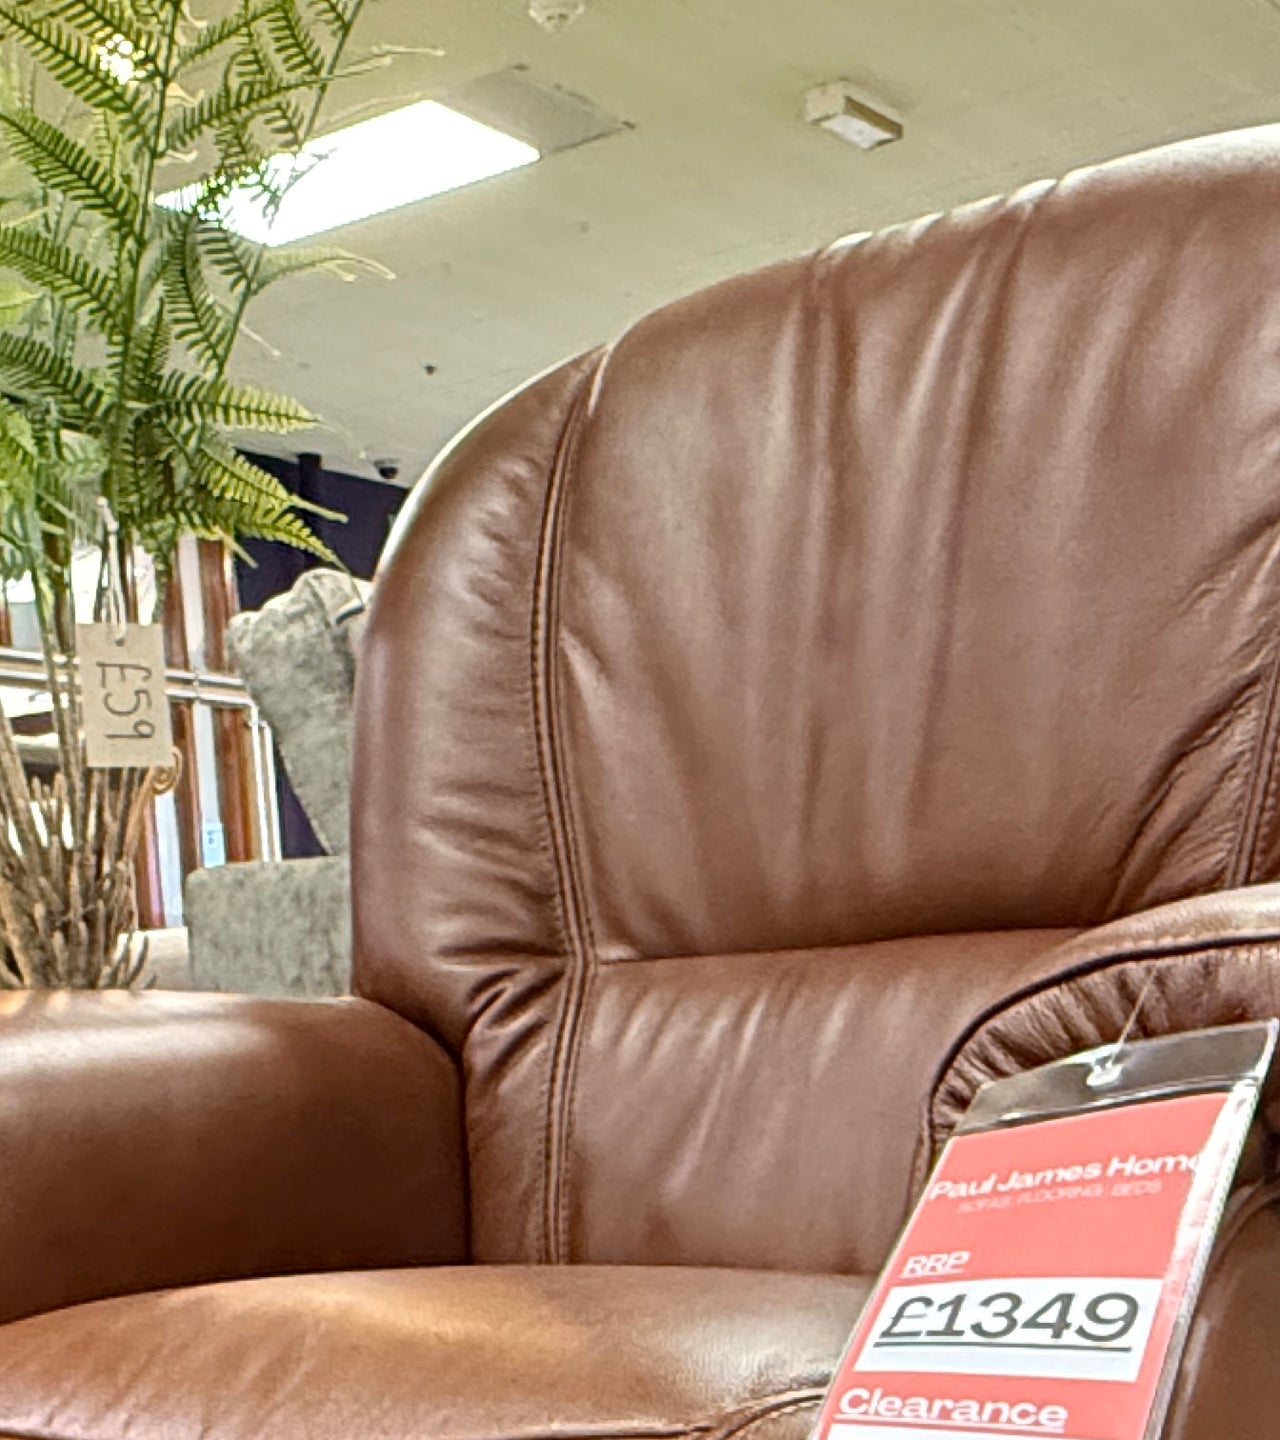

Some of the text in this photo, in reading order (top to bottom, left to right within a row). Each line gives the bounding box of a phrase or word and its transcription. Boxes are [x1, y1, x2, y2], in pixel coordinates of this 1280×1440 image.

[95, 661, 155, 739] £59
[929, 1173, 996, 1201] Paul
[996, 1162, 1102, 1192] James
[902, 1251, 970, 1277] RRP
[879, 1292, 1139, 1342] £1349
[839, 1388, 1068, 1426] Clearance
